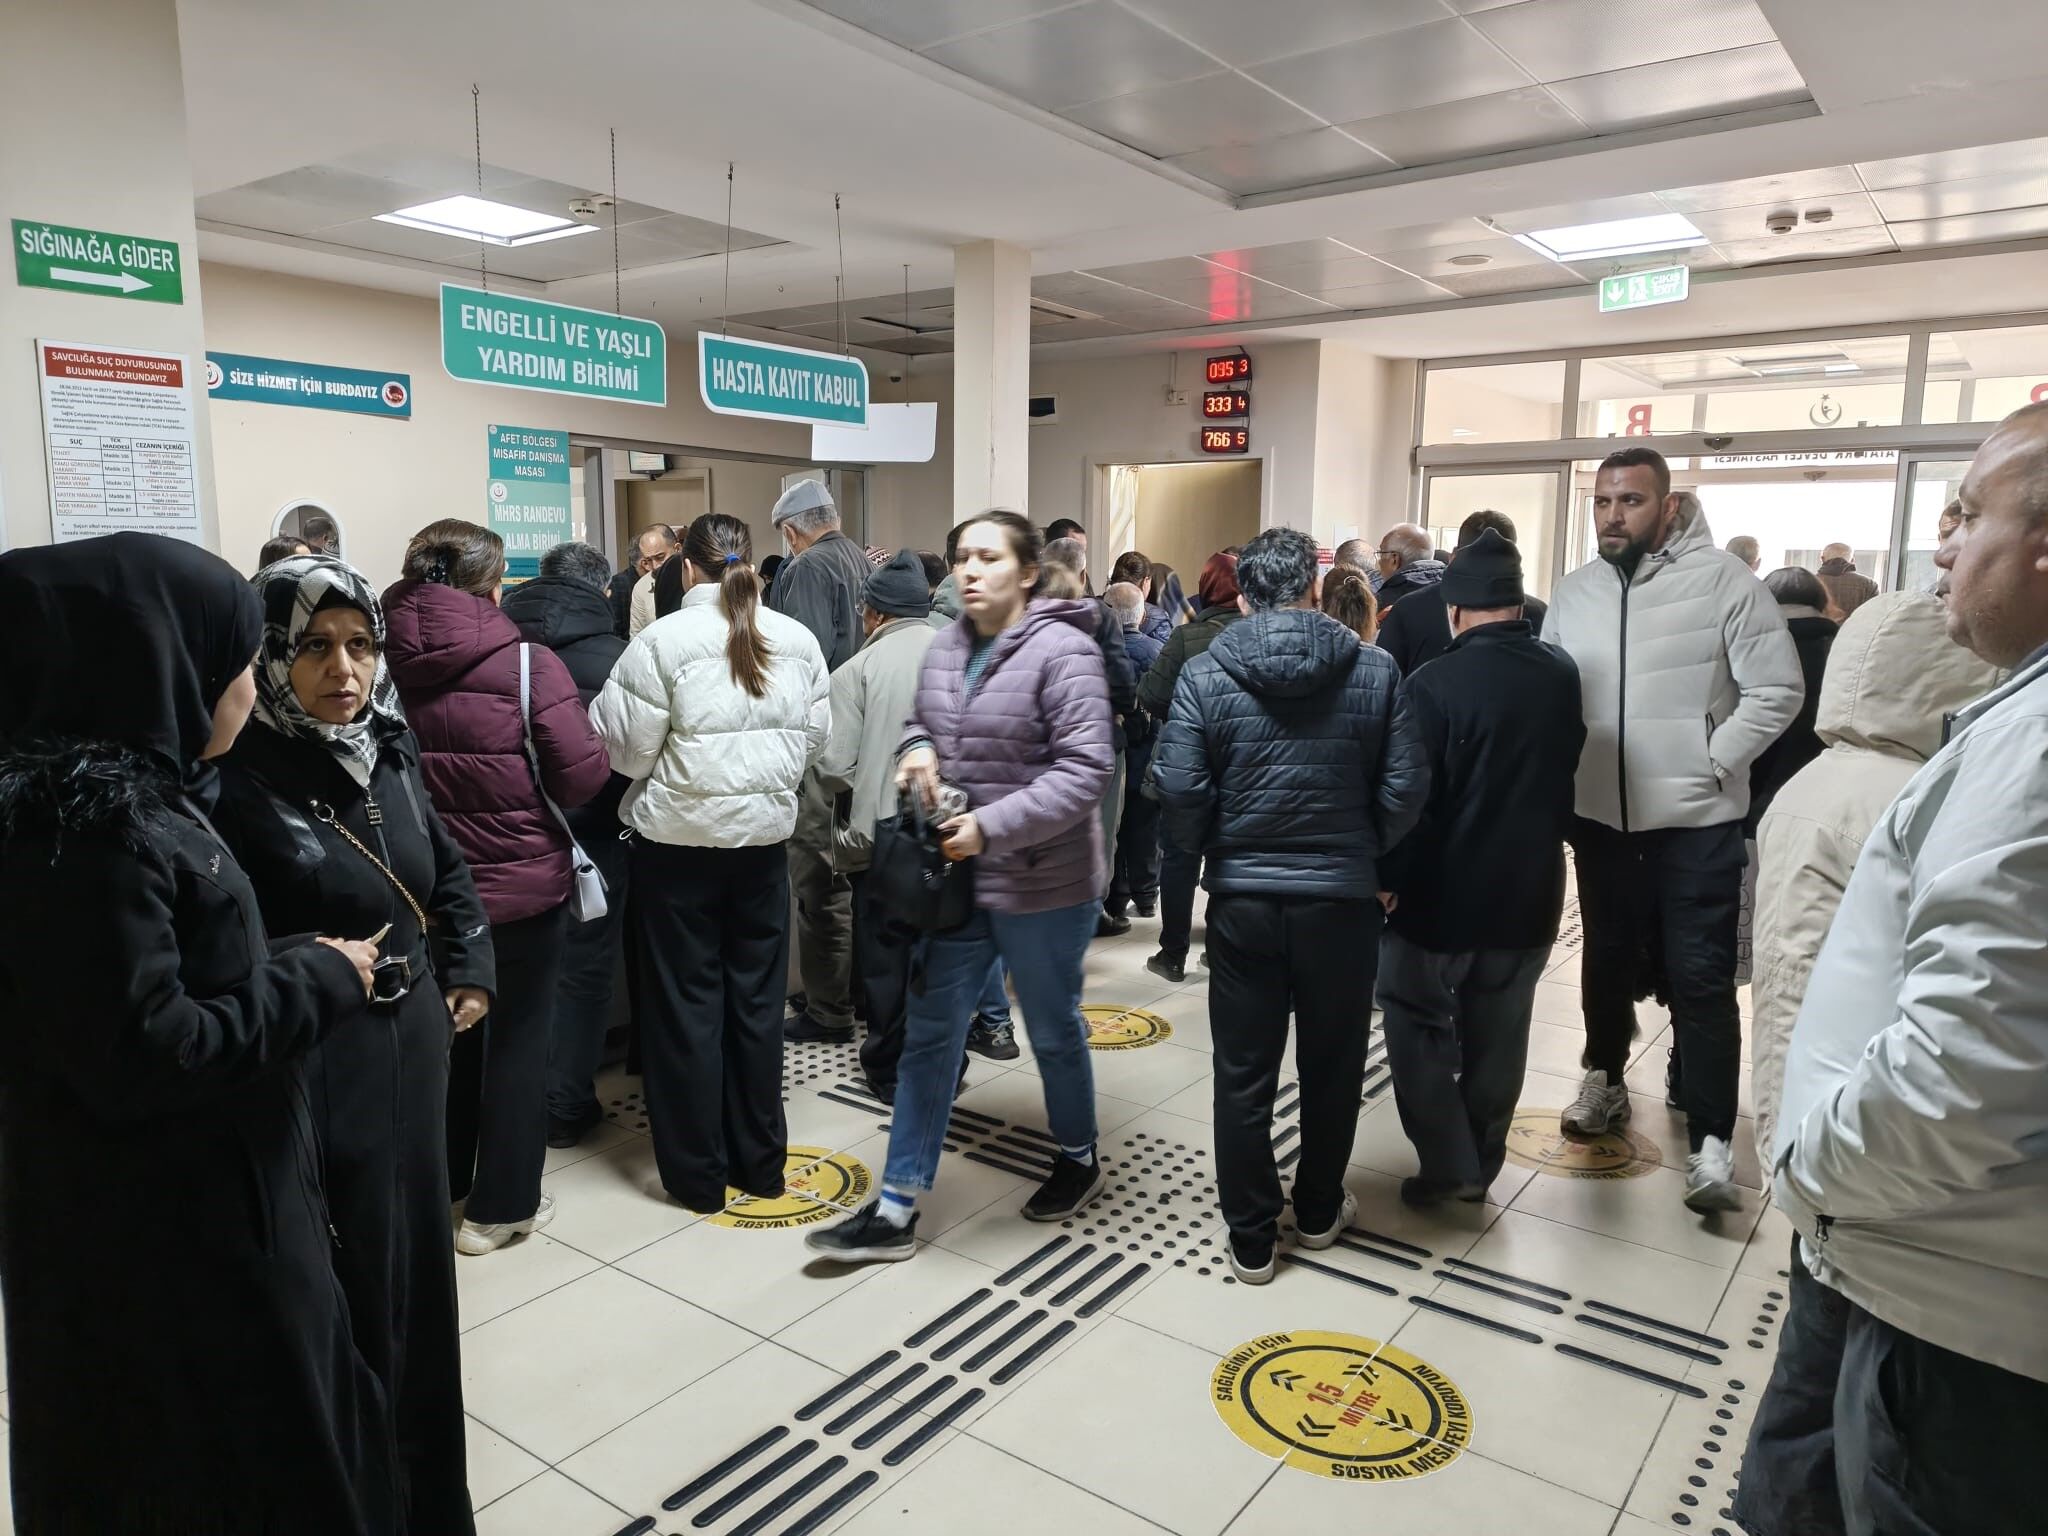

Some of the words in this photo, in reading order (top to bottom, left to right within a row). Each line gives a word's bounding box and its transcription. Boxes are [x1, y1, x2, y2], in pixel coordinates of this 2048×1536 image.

[21, 226, 115, 265] SIĞINAĞA
[119, 240, 175, 272] GİDER
[461, 304, 556, 343] ENGELLİ
[563, 321, 590, 348] VE
[595, 327, 651, 359] YAŞLI
[51, 351, 95, 364] SAVCILIĞA
[97, 356, 113, 367] SUÇ
[115, 358, 178, 372] DUYURUSUNDA
[477, 346, 566, 382] YARDIM
[573, 358, 639, 392] BİRİMİ
[1240, 359, 1248, 373] 3
[65, 366, 114, 378] BULUNMAK
[116, 371, 168, 383] ZORUNDAYIZ
[230, 367, 254, 386] SİZE
[256, 371, 298, 391] HİZMET
[300, 376, 322, 396] İÇİN
[325, 382, 378, 399] BURDAYIZ
[712, 357, 765, 396] HASTA
[768, 365, 811, 401] KAYIT
[814, 372, 861, 408] KABUL
[1206, 396, 1232, 413] 333
[1238, 395, 1246, 409] 4
[500, 432, 521, 444] AFET
[1205, 432, 1231, 447] 766
[1237, 432, 1246, 445] 5
[493, 447, 527, 460] MİSAFİR
[528, 452, 565, 465] DANIŞMA
[514, 466, 545, 477] MASASI
[494, 504, 521, 522] MHRS
[522, 505, 566, 524] RANDEVU
[505, 532, 530, 550] ALMA
[733, 1219, 793, 1228] SOSYAL
[1213, 1347, 1260, 1402] SAĞLIĞINIZ
[1252, 1334, 1292, 1350] İÇİN
[1331, 1463, 1413, 1480] SOSYAL
[1411, 1364, 1467, 1419] KORUYUN
